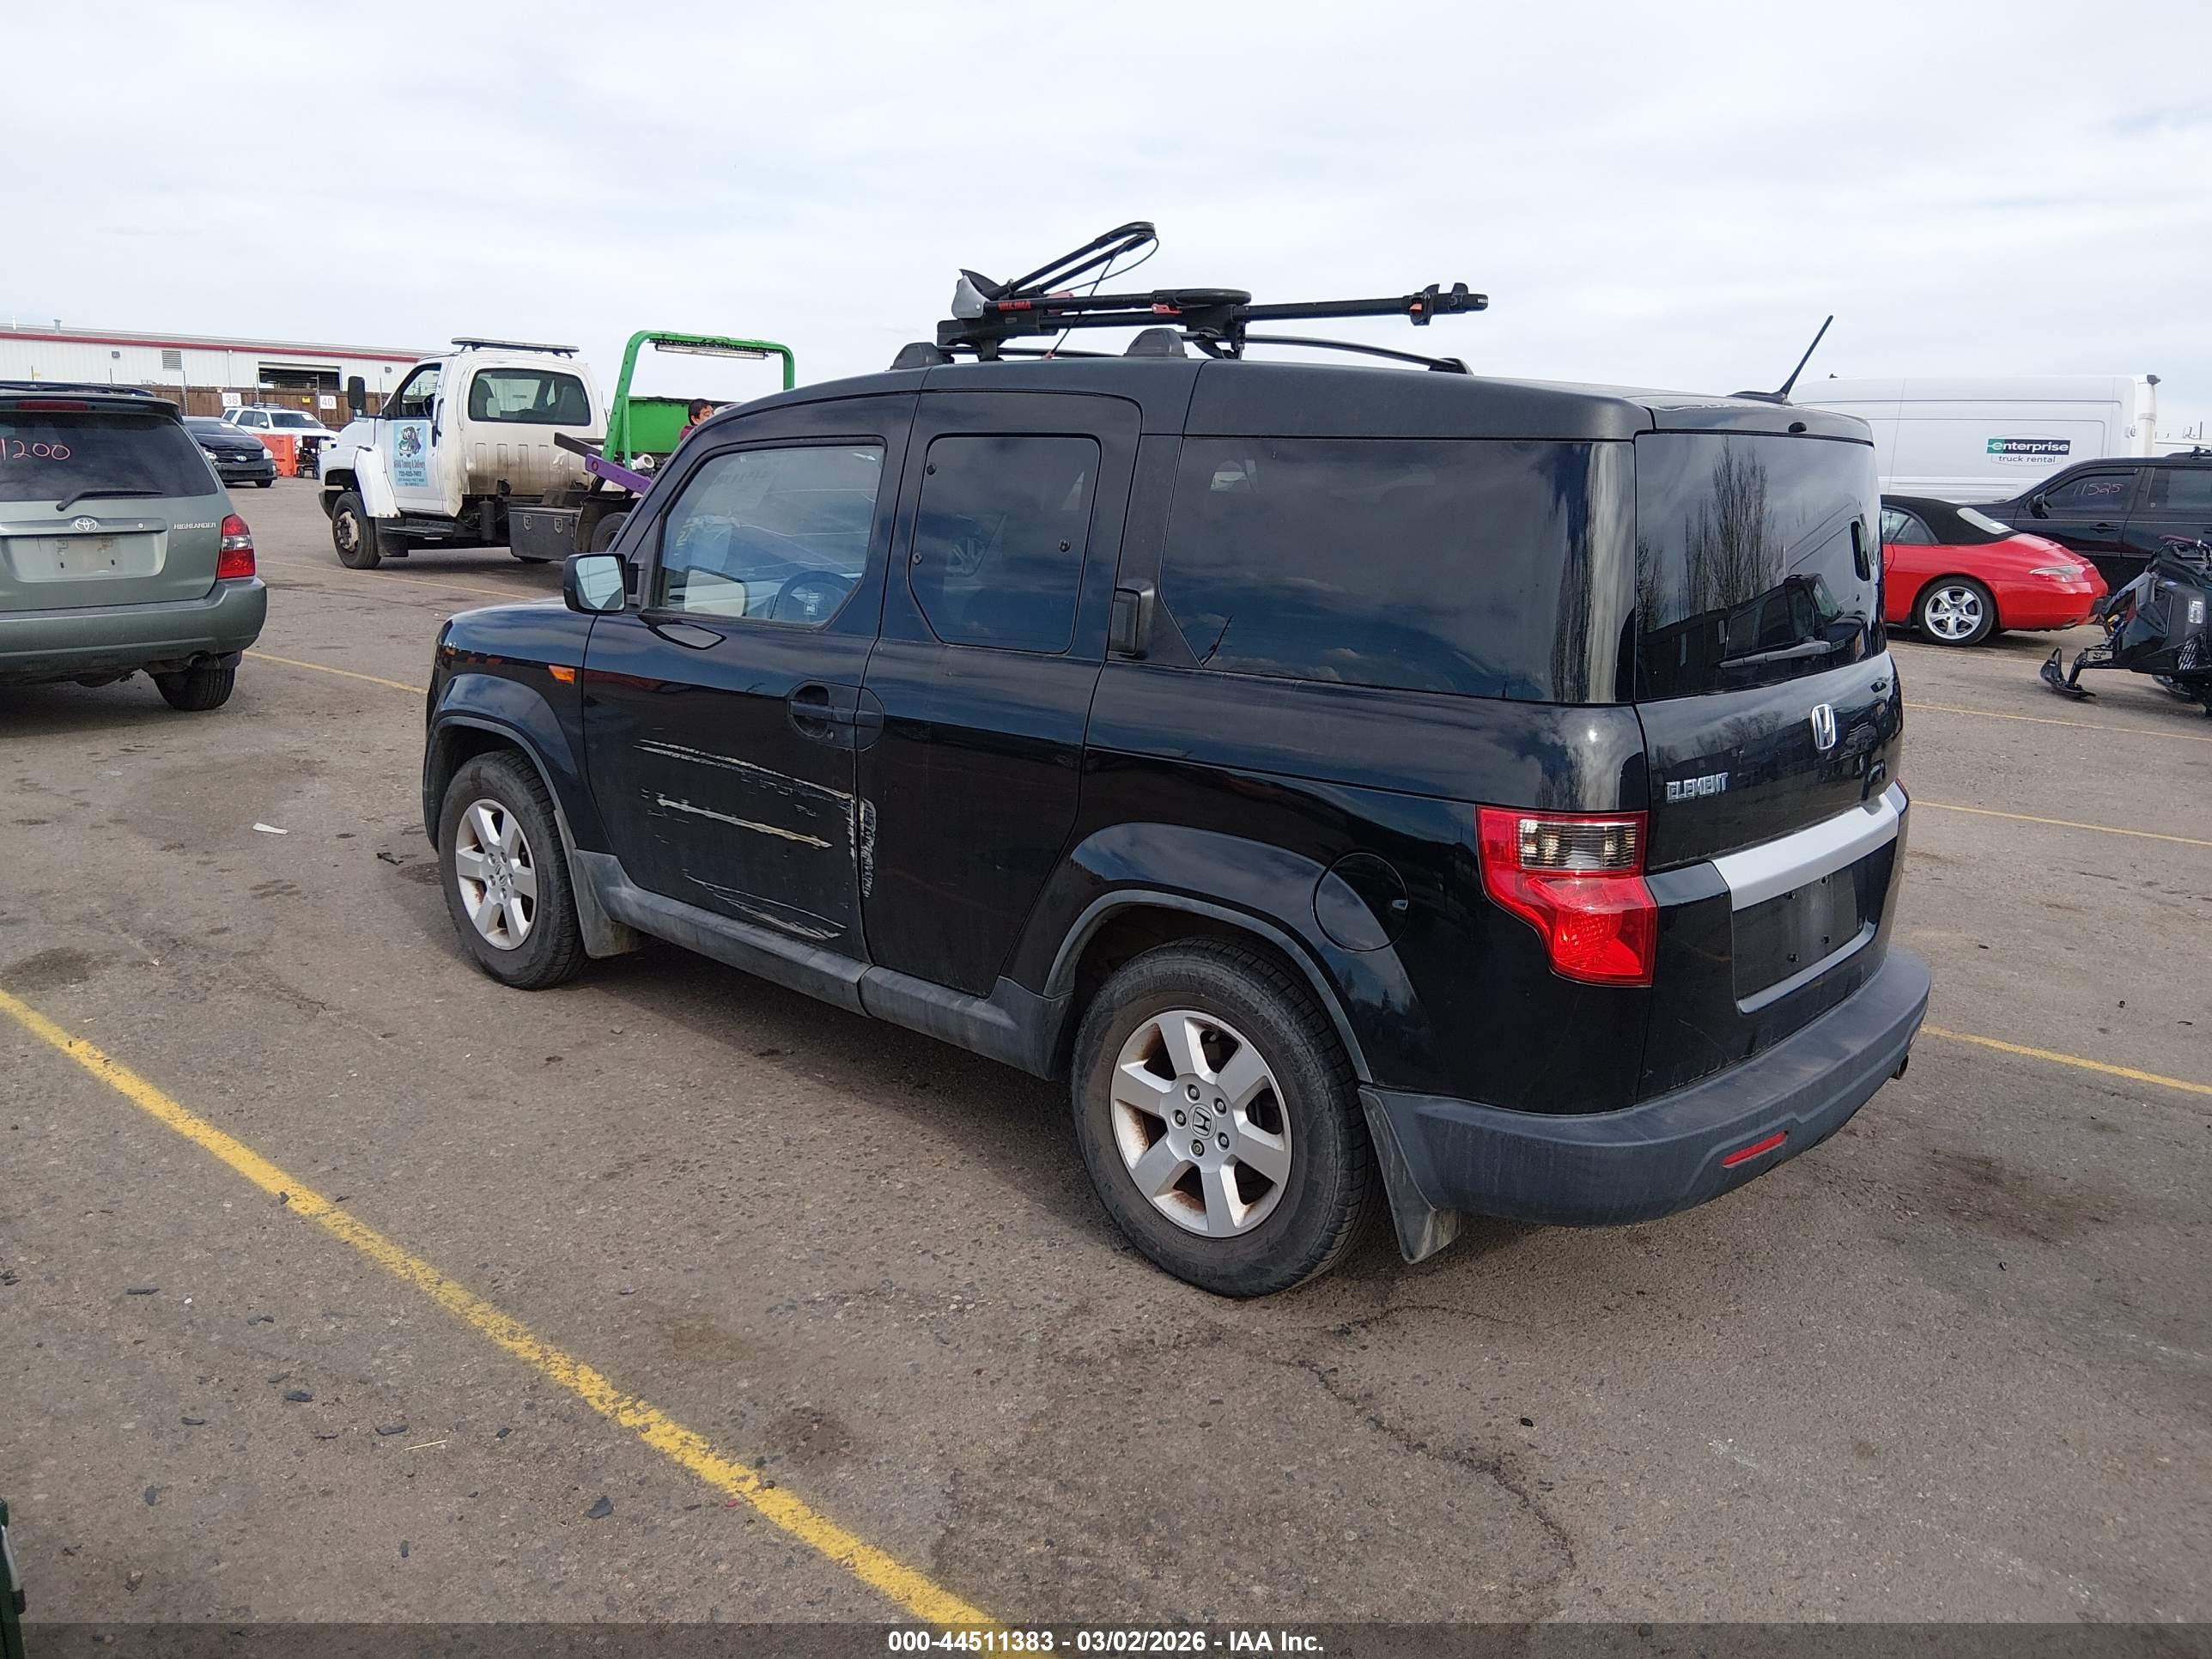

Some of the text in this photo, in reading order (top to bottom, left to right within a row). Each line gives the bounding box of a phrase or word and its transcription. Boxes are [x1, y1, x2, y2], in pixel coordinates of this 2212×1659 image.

[225, 394, 239, 405] 38
[321, 397, 333, 407] 40
[1991, 441, 2069, 453] enterprise
[2026, 455, 2056, 464] rental
[173, 521, 216, 530] HIGHLANDER
[1665, 772, 1729, 801] ELEMENT
